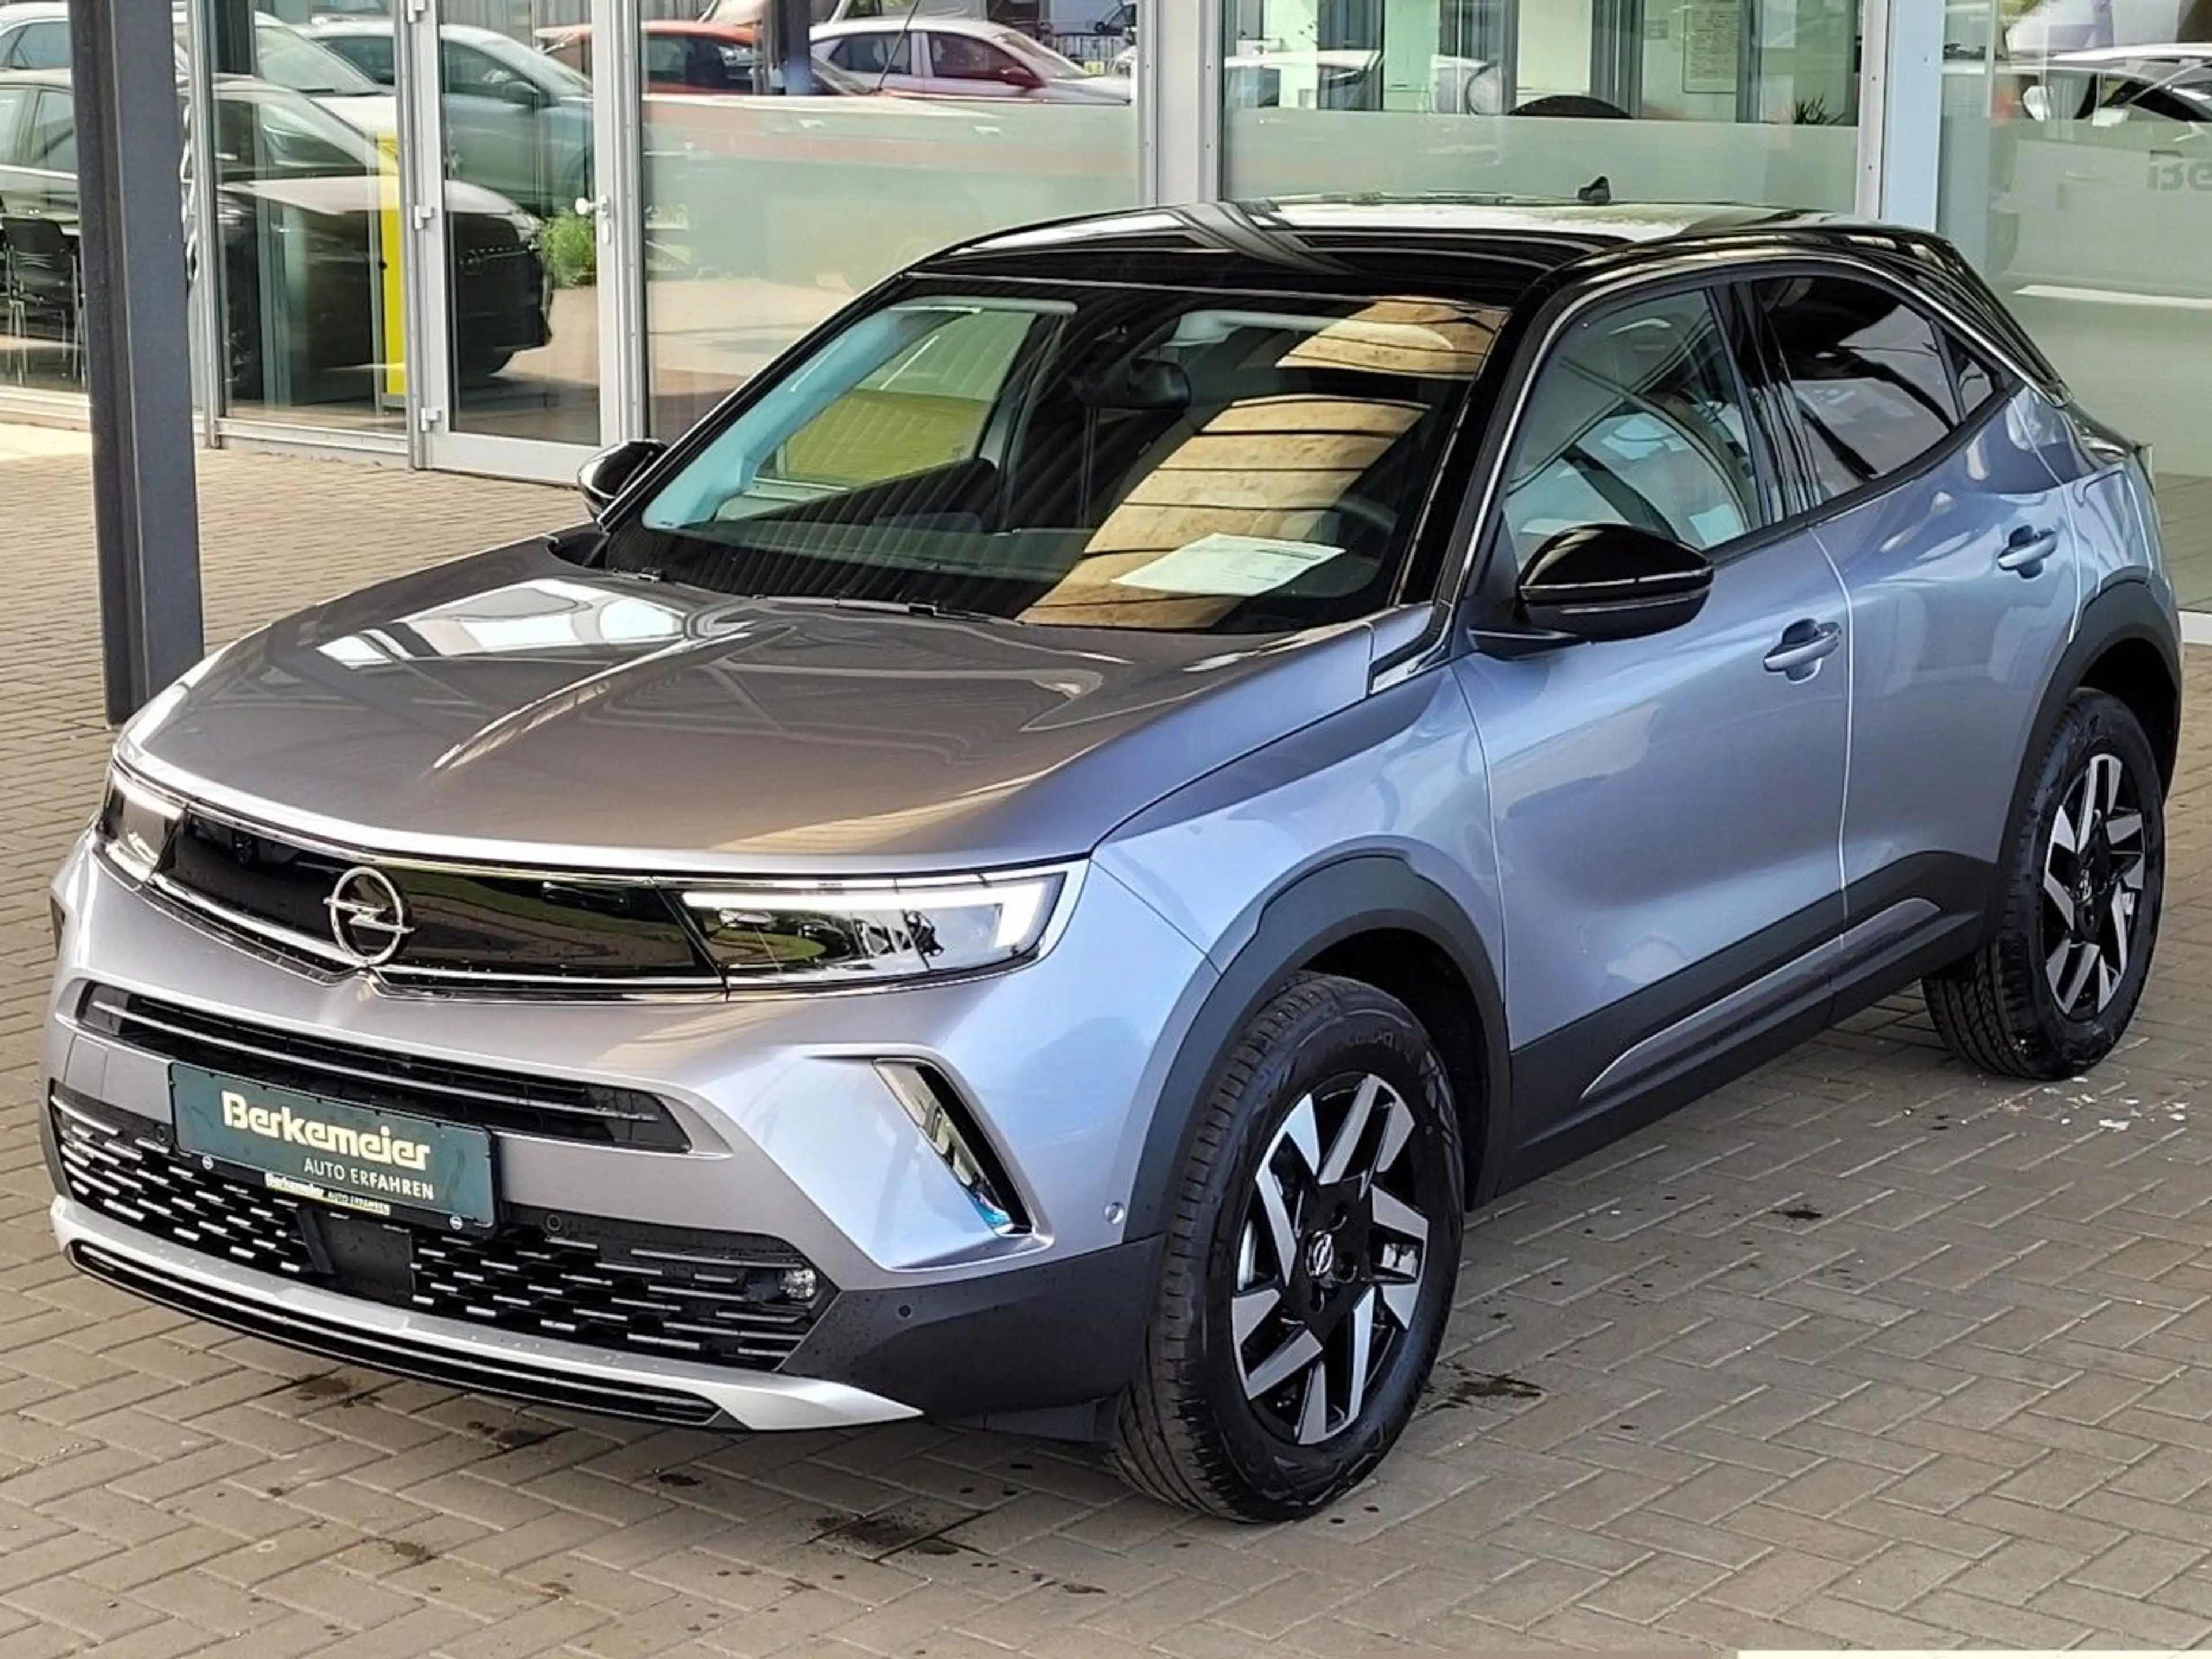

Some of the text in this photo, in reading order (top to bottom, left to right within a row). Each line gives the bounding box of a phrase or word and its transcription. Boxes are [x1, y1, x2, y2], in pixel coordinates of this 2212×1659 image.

[221, 1090, 431, 1171] Berkemeier
[304, 1158, 435, 1200] AUTO ERFAHREN
